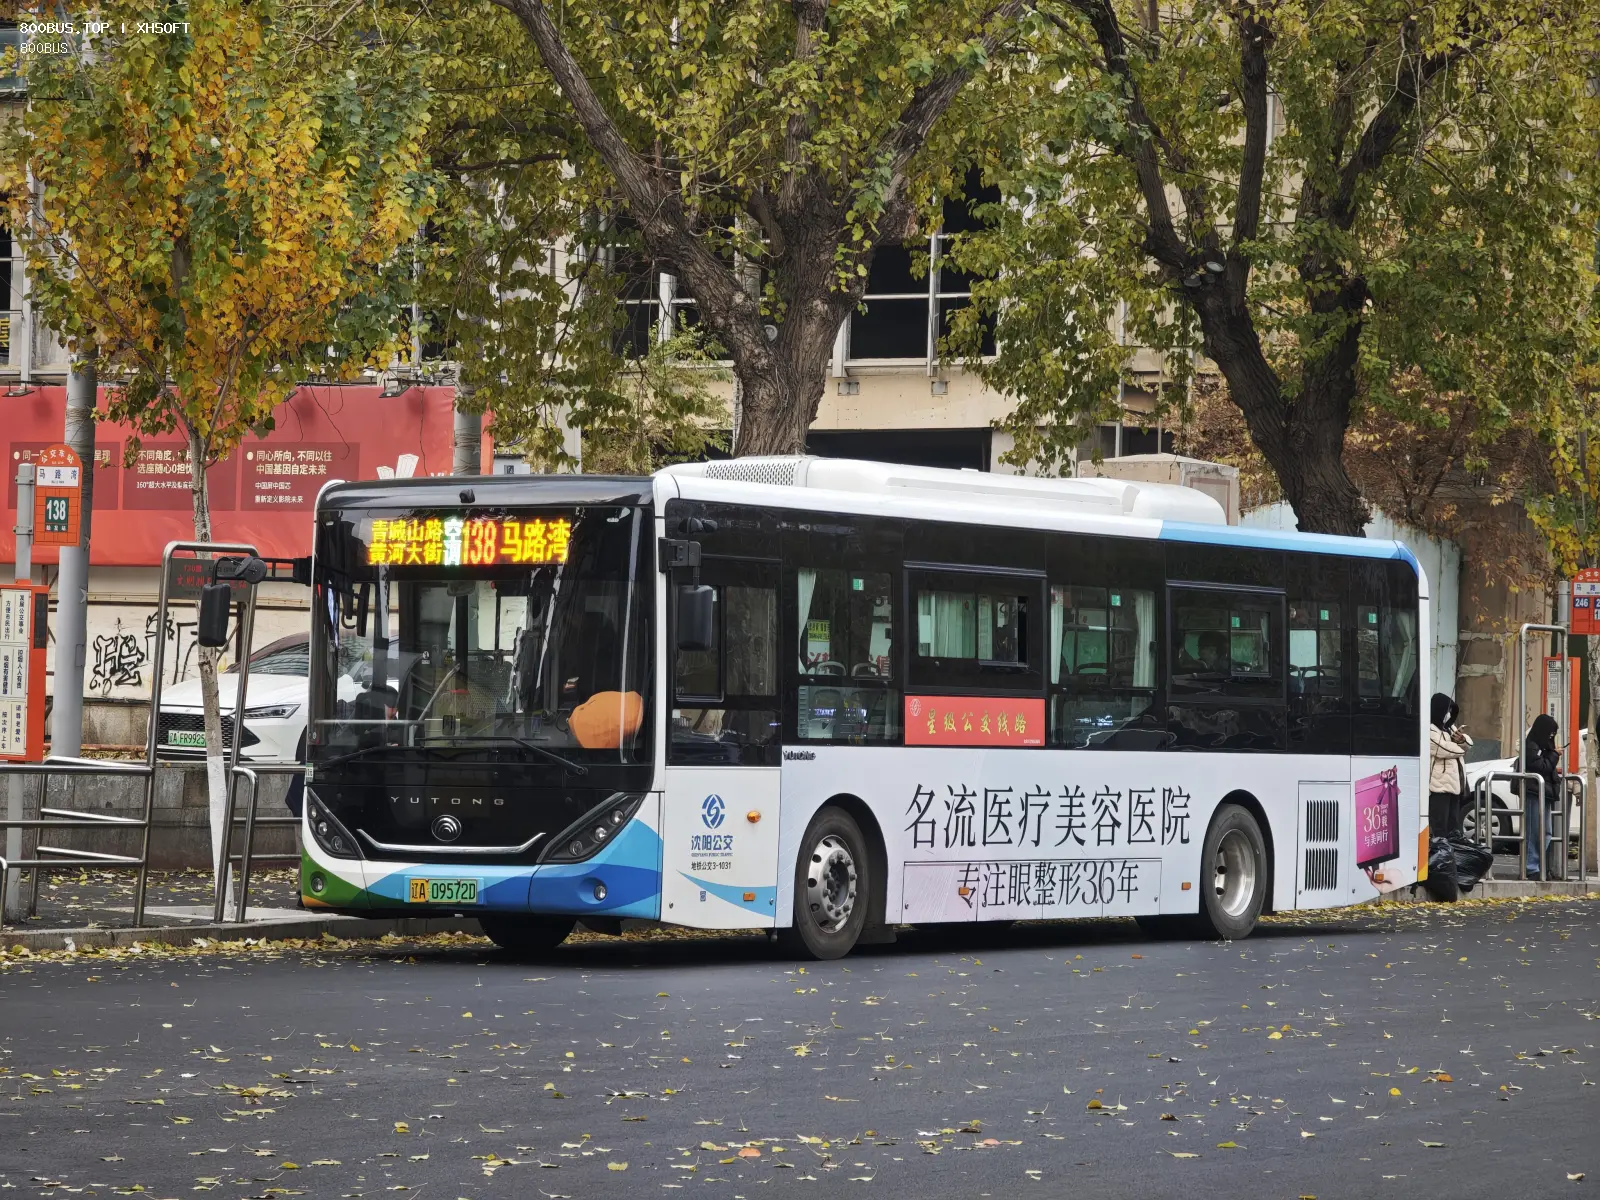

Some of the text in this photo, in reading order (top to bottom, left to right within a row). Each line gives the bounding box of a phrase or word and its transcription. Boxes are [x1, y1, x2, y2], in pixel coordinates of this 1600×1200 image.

[256, 464, 327, 475] 中国基因自定未来
[46, 499, 66, 521] 138
[371, 519, 442, 541] 青城山路
[501, 519, 571, 562] 马路湾
[463, 520, 497, 564] 138
[369, 543, 442, 565] 黄河大街
[1575, 598, 1589, 608] 246
[927, 708, 1027, 737] 星级公交线路
[390, 796, 505, 806] YUTONG
[904, 783, 1191, 848] 名流医疗美容医院
[691, 834, 734, 851] 沈阳公交
[957, 859, 1139, 908] 专注眼整形36年
